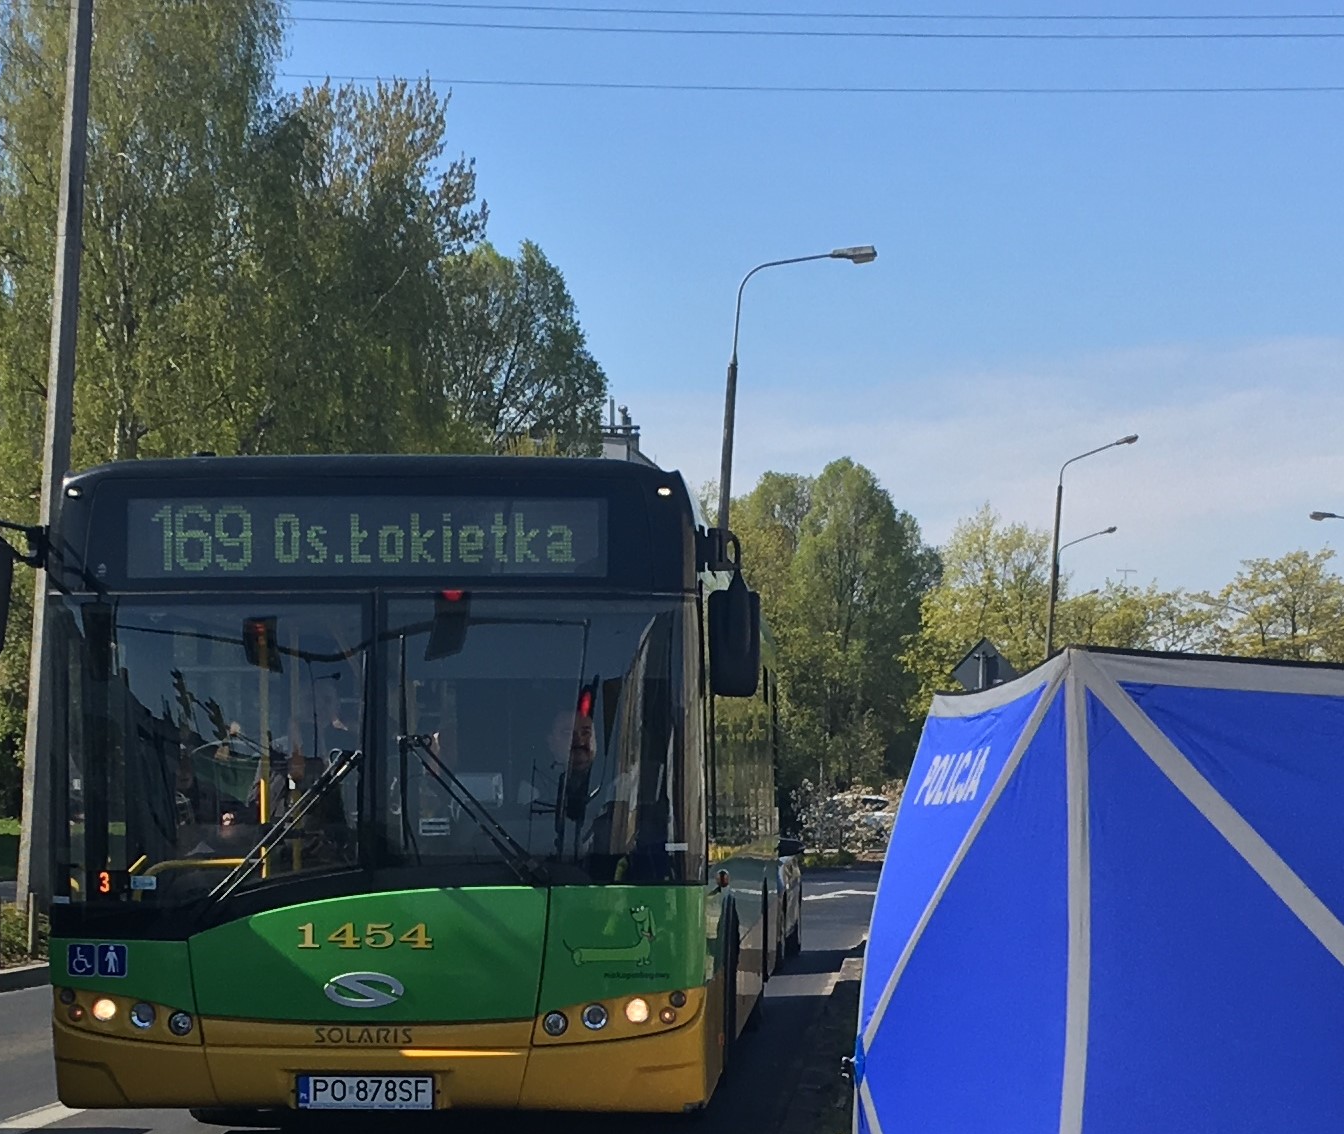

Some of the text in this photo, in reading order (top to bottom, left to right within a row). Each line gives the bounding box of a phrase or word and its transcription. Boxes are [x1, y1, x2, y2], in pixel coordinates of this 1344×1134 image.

[151, 505, 252, 571] 169
[913, 746, 991, 806] POLICJA
[99, 871, 110, 892] 3
[297, 922, 434, 949] 1454
[314, 1027, 413, 1044] SOLARIS
[312, 1079, 429, 1102] PO 878SF
